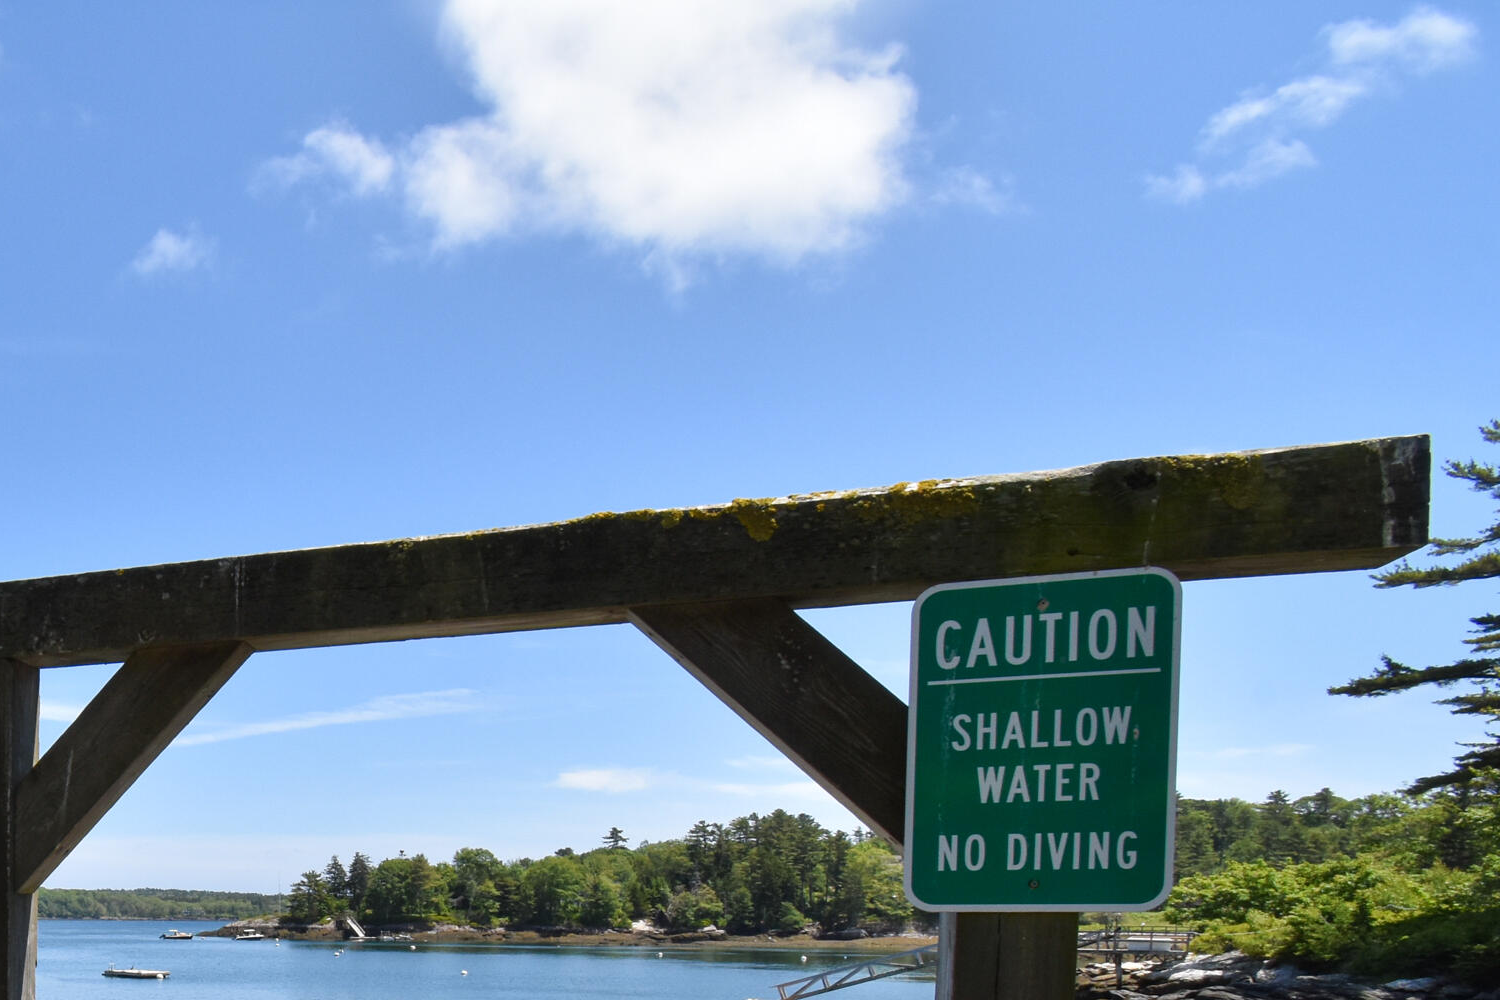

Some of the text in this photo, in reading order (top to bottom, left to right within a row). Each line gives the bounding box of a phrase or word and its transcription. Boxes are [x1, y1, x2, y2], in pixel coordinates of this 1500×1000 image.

[935, 606, 1157, 670] CAUTION
[951, 706, 1132, 751] SHALLOW
[977, 762, 1101, 804] WATER
[937, 831, 1138, 872] NO DIVING
